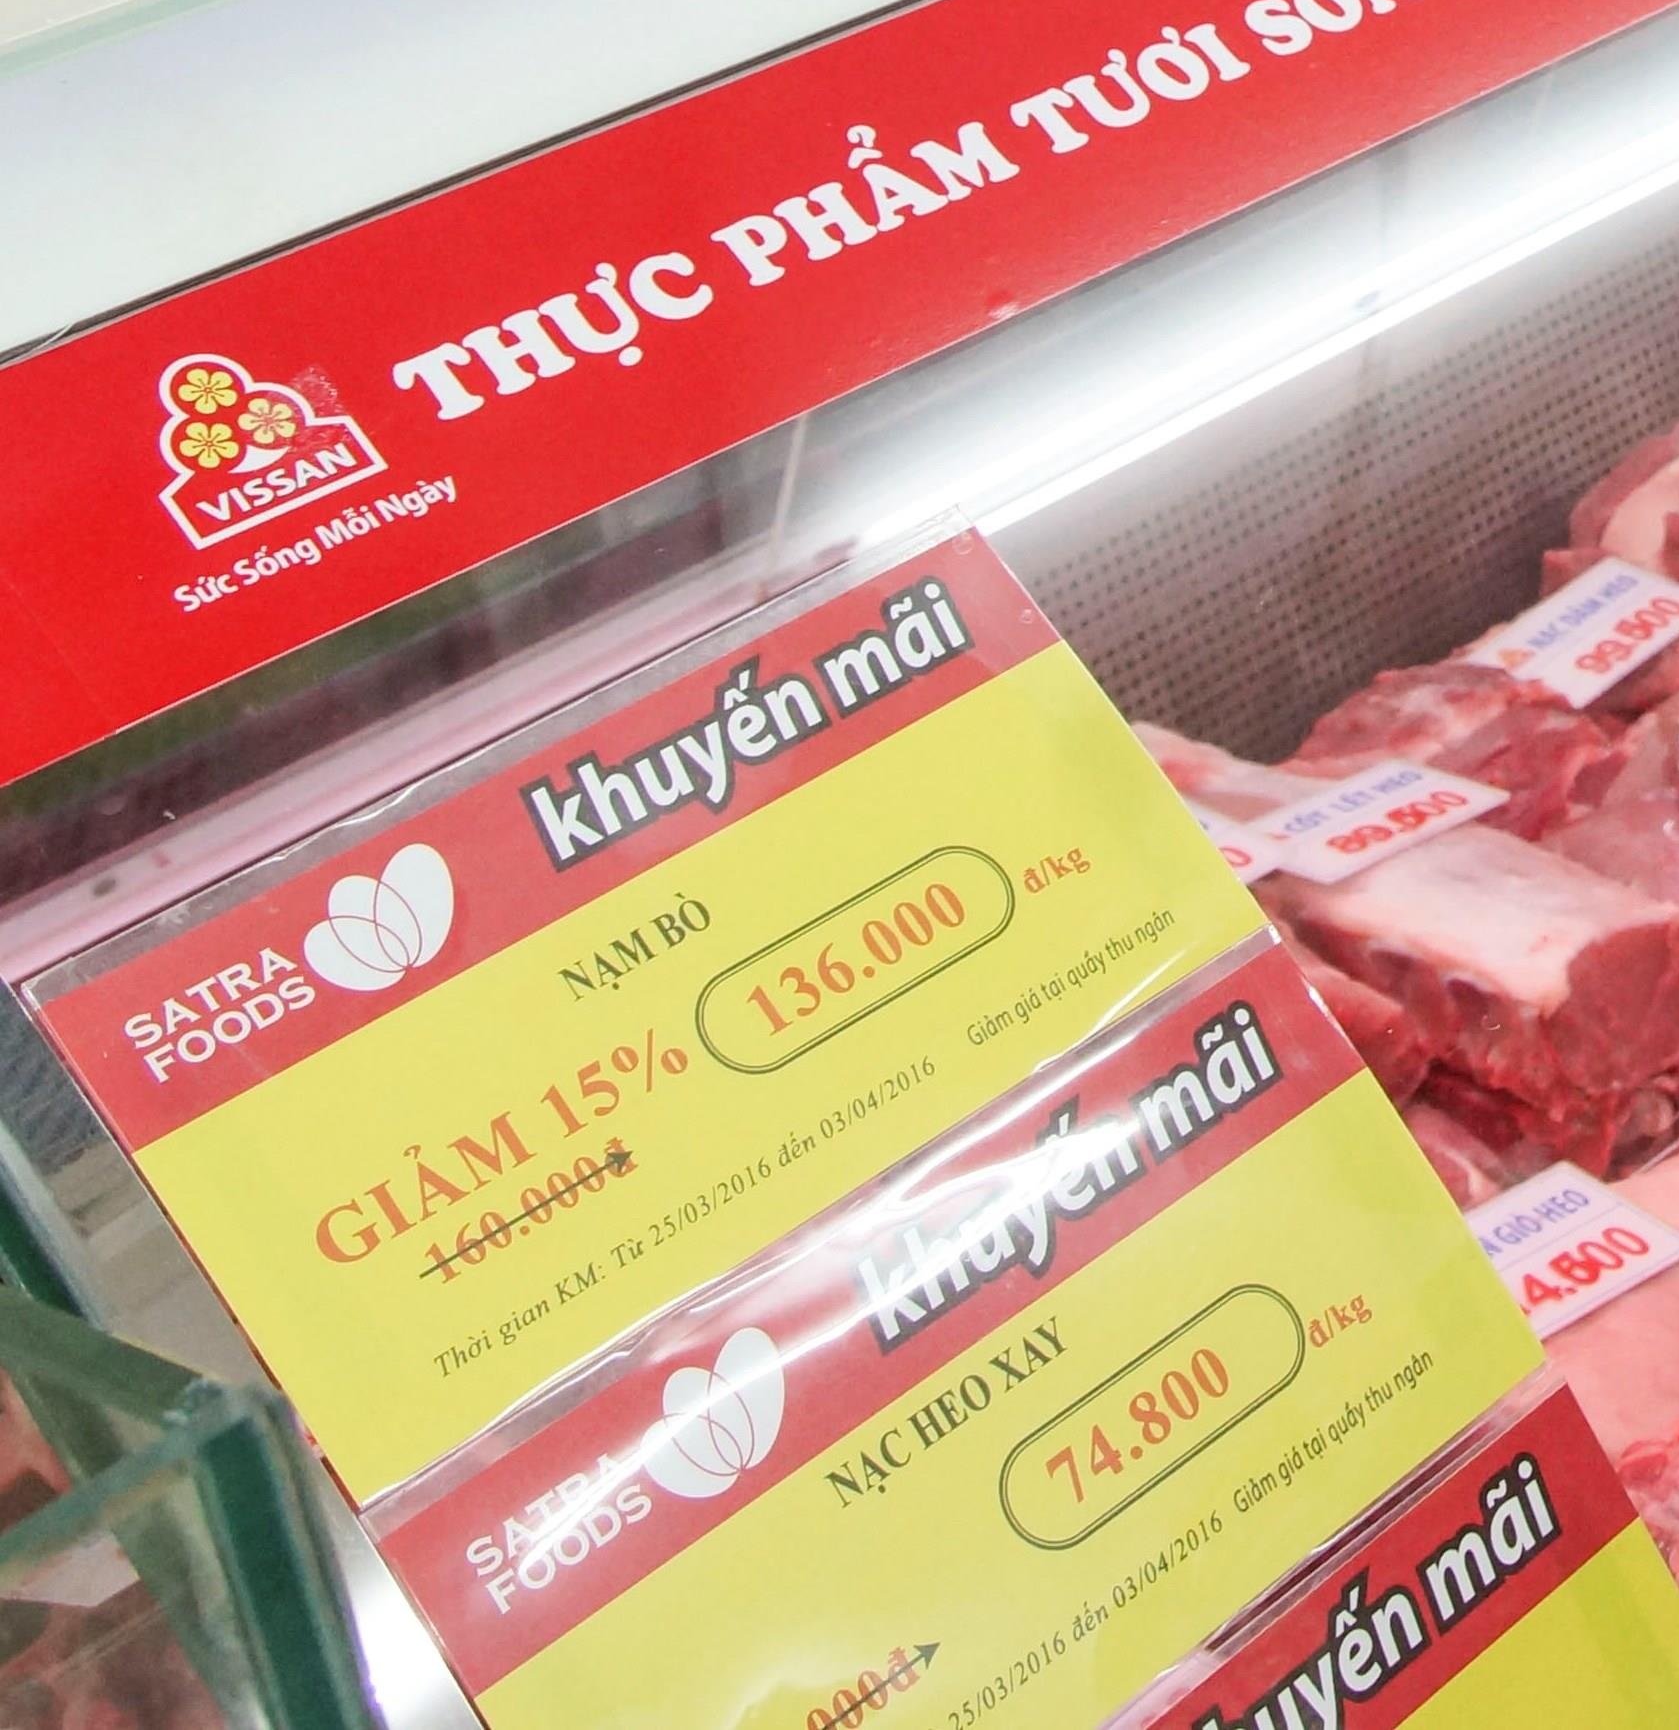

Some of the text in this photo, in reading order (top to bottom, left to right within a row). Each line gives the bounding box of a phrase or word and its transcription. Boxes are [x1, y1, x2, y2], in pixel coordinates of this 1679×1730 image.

[391, 251, 716, 422] THỰC
[710, 123, 1021, 288] PHẨM
[1010, 22, 1250, 154] TƯƠI
[173, 474, 458, 613] Sức Sống Mỗi Ngày
[195, 442, 358, 522] VISSAN
[530, 582, 967, 862] khuyến mãi
[1021, 843, 1093, 896] đ/kg
[123, 946, 299, 1050] SATRA
[557, 890, 713, 1003] NẠM BÒ
[743, 881, 968, 1038] 136.000
[965, 1002, 1016, 1049] Giảm
[1013, 980, 1046, 1026] giá
[1103, 931, 1135, 968] thu
[1128, 907, 1177, 958] ngân
[143, 975, 317, 1084] FOODS
[1137, 1007, 1278, 1154] mãi
[313, 1026, 690, 1266] GIẢM 15%
[421, 1136, 640, 1287] 160.000đ
[1533, 1188, 1590, 1223] HEO
[432, 1327, 494, 1379] Thời
[497, 1297, 552, 1347] gian
[552, 1260, 608, 1306] KM:
[646, 1155, 776, 1249] 25/03/2016
[775, 1128, 820, 1170] đến
[818, 1055, 939, 1144] 03/04/2016
[1307, 1292, 1375, 1351] đ/kg
[1362, 1379, 1394, 1421] thu
[1391, 1347, 1436, 1400] ngân
[823, 1316, 1070, 1510] NẠC HEO XAY
[1044, 1347, 1231, 1509] 74.800
[484, 1483, 655, 1616] FOODS
[1069, 1597, 1112, 1646] đến
[1110, 1507, 1226, 1611] 03/04/2016
[1424, 1457, 1557, 1624] mãi
